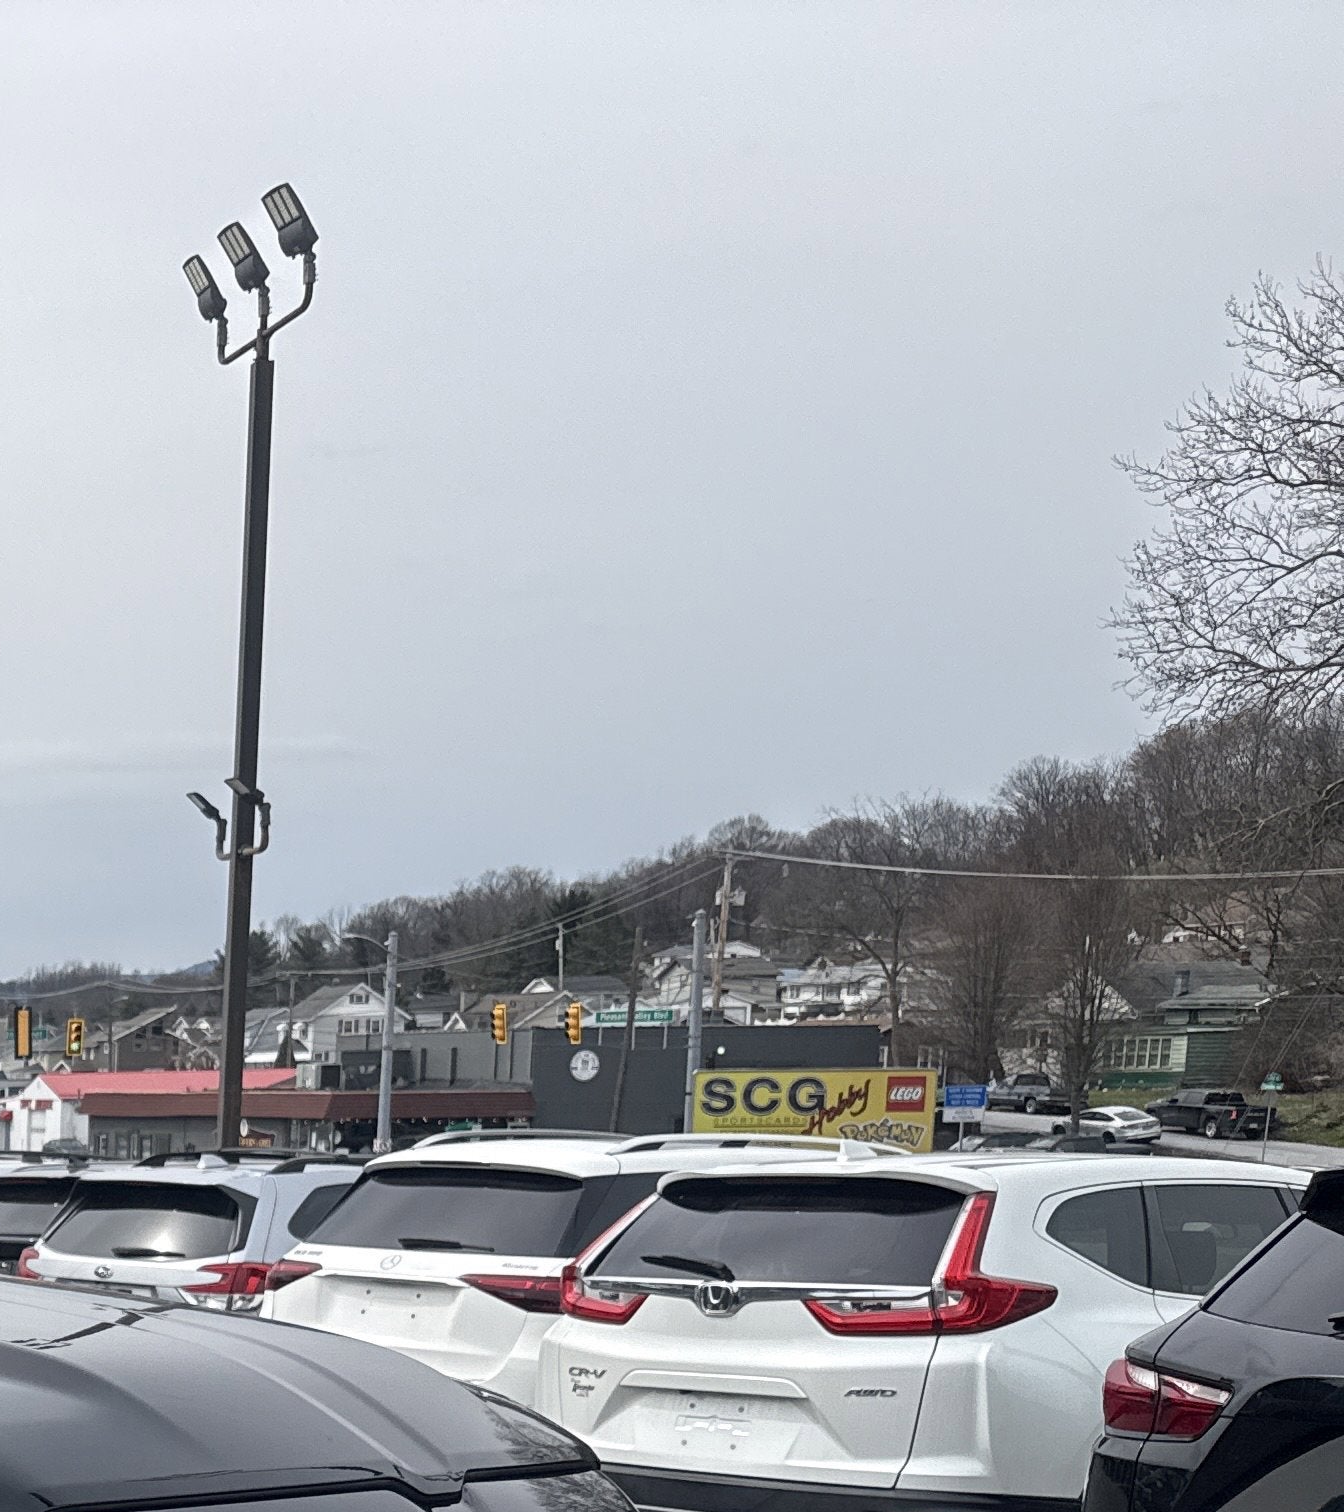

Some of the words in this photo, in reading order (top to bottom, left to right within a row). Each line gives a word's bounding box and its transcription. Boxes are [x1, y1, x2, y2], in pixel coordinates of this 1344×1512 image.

[700, 1076, 827, 1117] SCG
[801, 1079, 871, 1135] Hobby
[889, 1086, 924, 1102] LEGO
[844, 1388, 897, 1397] AWD
